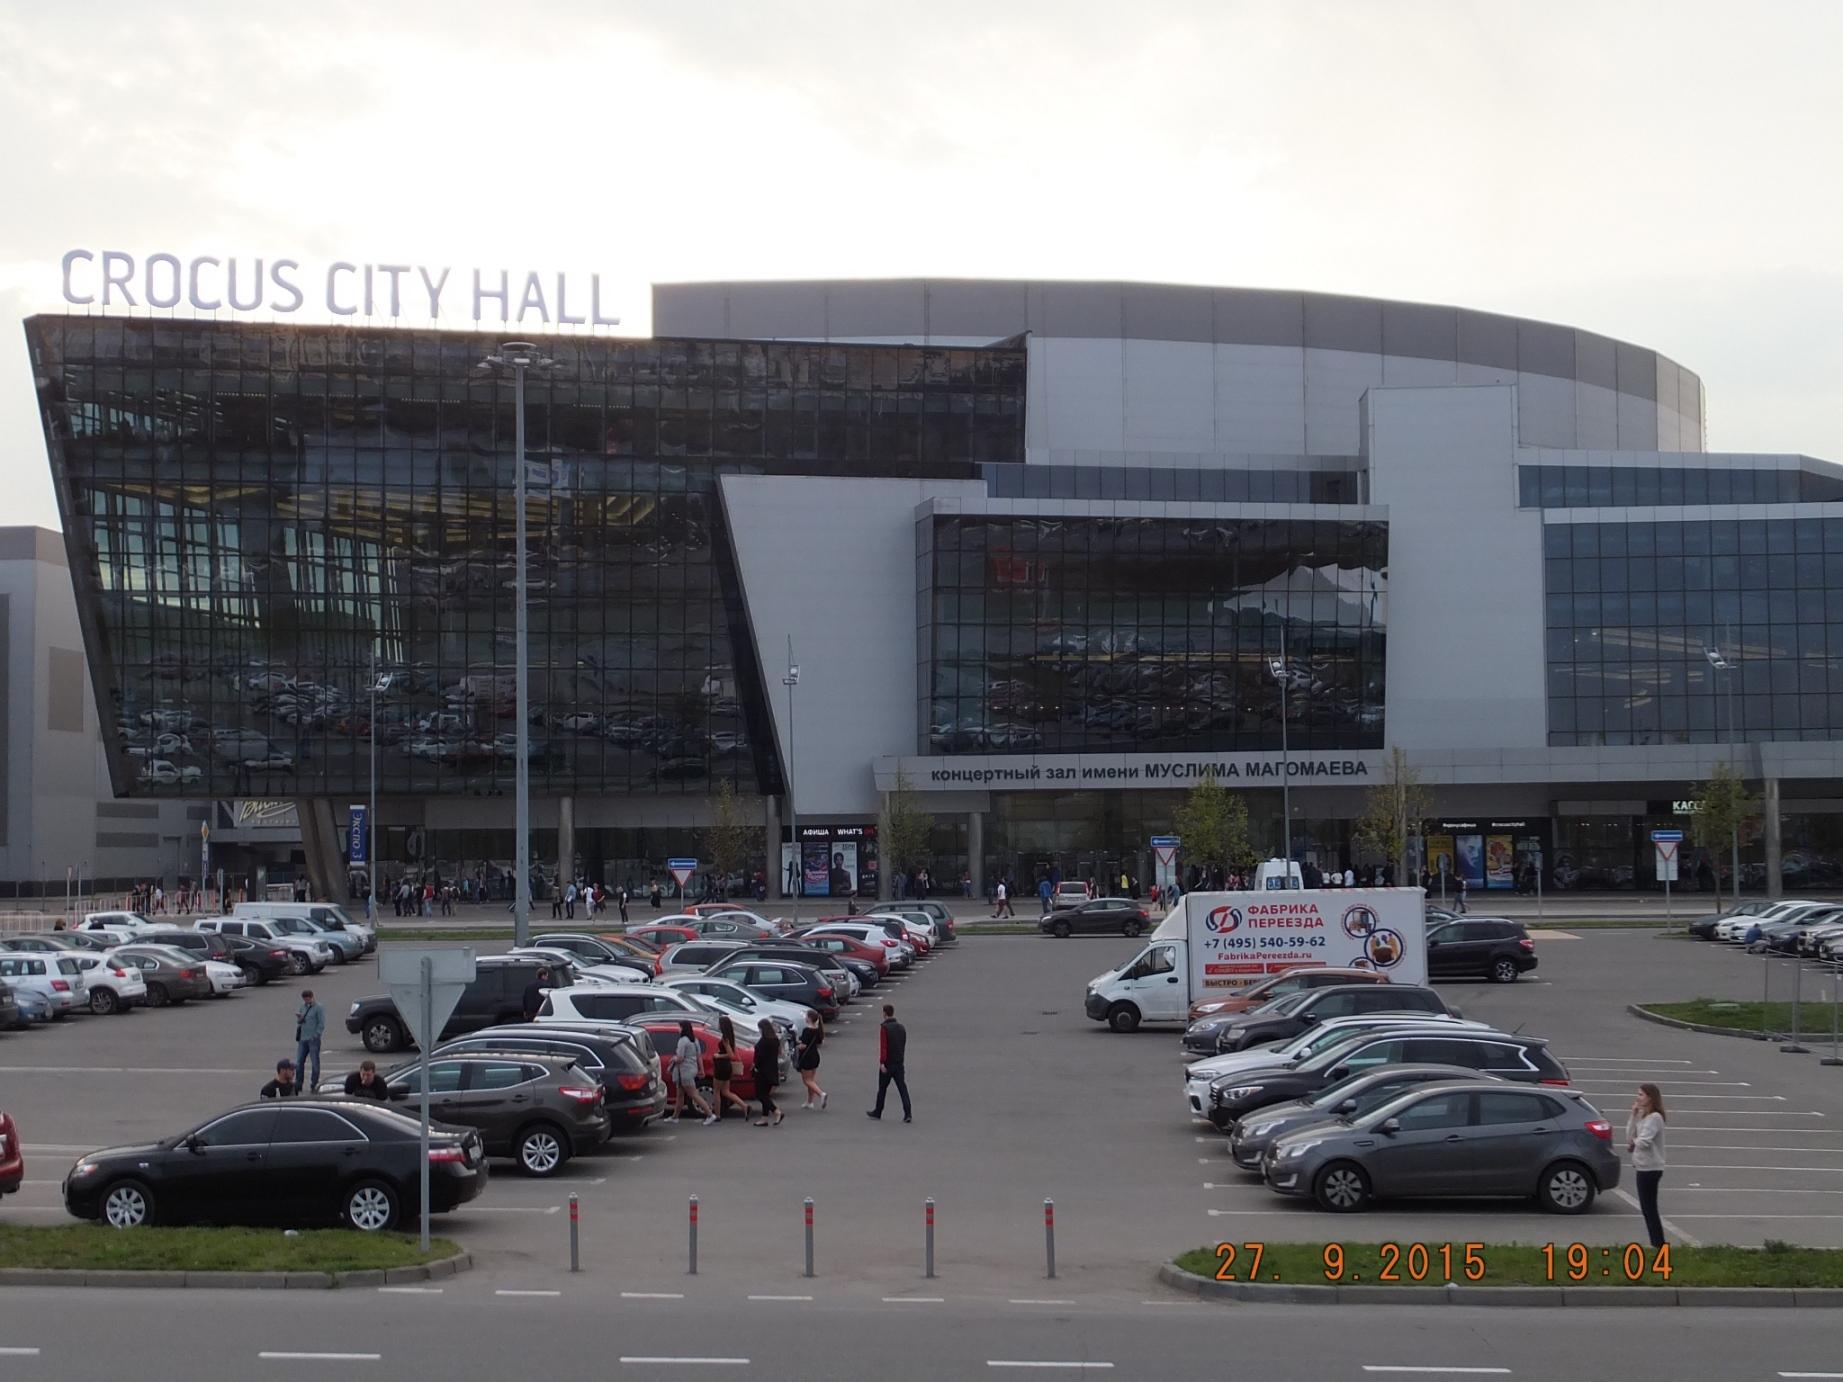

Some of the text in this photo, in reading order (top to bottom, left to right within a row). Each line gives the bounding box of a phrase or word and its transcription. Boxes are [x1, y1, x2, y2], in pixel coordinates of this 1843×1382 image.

[61, 248, 621, 326] CROCUS CITY HALL
[931, 760, 1368, 783] концертный зал имени МУСЛИМА МАГОМАЕВА
[1248, 904, 1319, 915] ФАБРИКА
[1248, 918, 1325, 929] ПЕРЕЕЗДА
[1204, 936, 1326, 949] +7 (495) 540-59-62
[1218, 951, 1312, 960] FabrikaPereezda.ru
[1205, 979, 1238, 987] БЫСТРО
